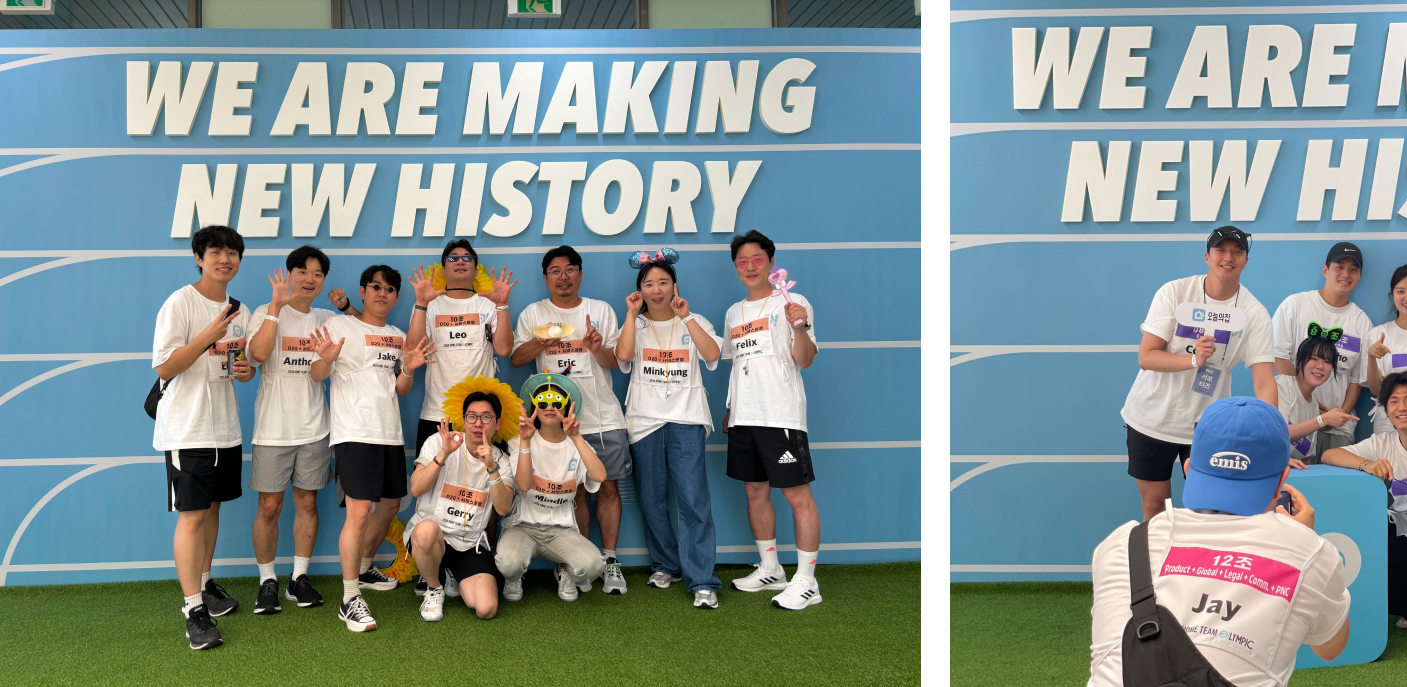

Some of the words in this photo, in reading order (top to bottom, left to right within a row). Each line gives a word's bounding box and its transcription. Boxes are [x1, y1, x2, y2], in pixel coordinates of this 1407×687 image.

[1012, 26, 1153, 110] WE
[1165, 23, 1358, 109] ARE
[127, 60, 258, 136] WE
[270, 61, 444, 136] ARE
[463, 58, 817, 135] MAKING
[1061, 140, 1282, 223] NEW
[171, 163, 376, 238] NEW
[391, 159, 763, 238] HISTORY
[1207, 312, 1230, 323] 오늘의집
[449, 331, 467, 339] Leo
[736, 339, 757, 350] Felix
[283, 357, 312, 366] Antho
[377, 353, 396, 361] Jake
[558, 359, 576, 367] Eric
[643, 367, 688, 378] Minkyung
[1210, 456, 1248, 470] emis
[447, 507, 474, 521] Gerry
[1213, 555, 1253, 571] 12조
[1164, 564, 1191, 574] Product
[1197, 566, 1218, 576] Global
[1224, 569, 1243, 581] Legal
[1276, 585, 1290, 597] PNC
[1191, 593, 1242, 621] Jay
[1200, 625, 1218, 636] TEAM
